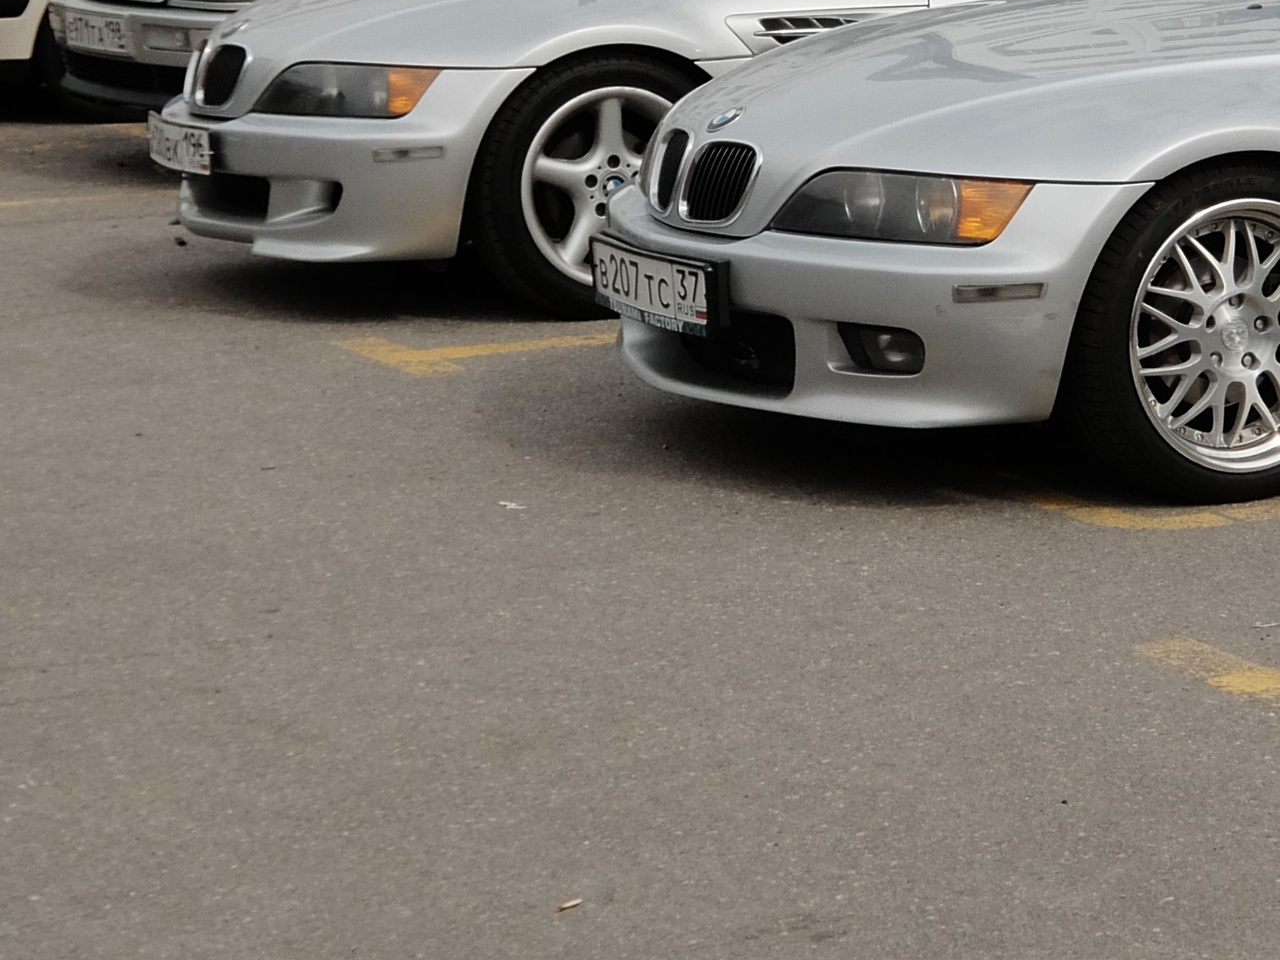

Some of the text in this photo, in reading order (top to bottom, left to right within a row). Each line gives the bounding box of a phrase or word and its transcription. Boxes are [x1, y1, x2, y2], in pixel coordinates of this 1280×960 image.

[676, 269, 699, 303] 37
[677, 302, 695, 318] RUS
[643, 312, 684, 333] FACTORY
